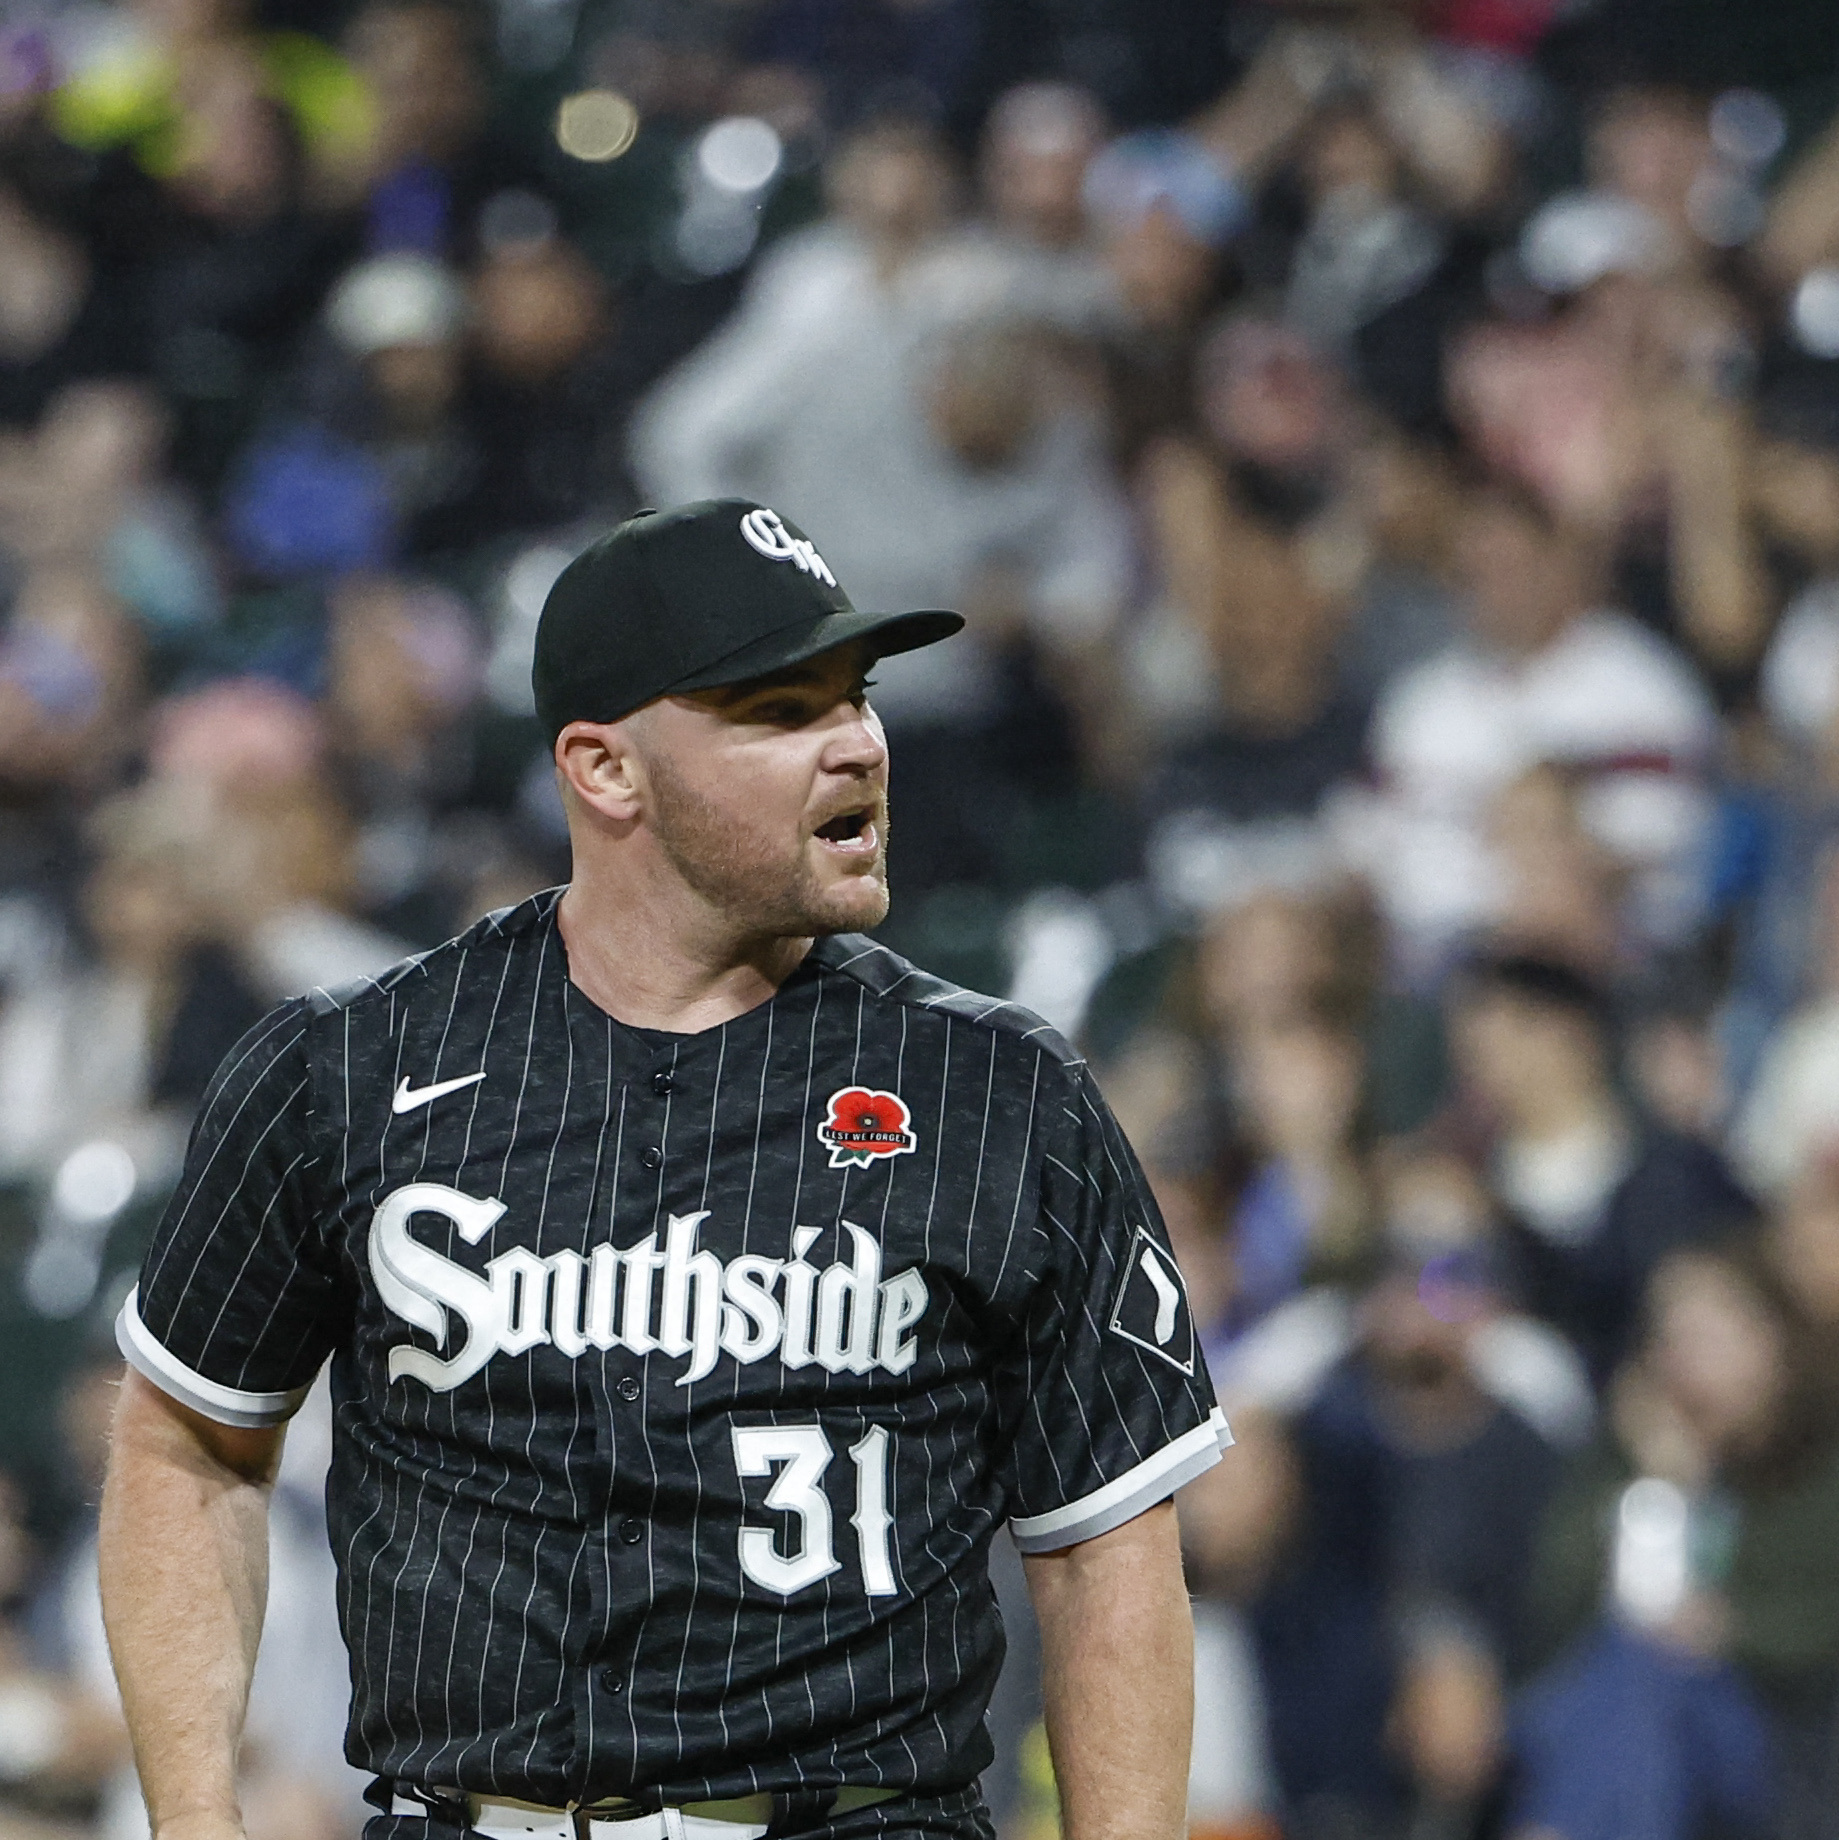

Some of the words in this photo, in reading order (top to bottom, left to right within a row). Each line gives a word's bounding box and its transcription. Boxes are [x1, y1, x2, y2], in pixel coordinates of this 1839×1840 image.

[825, 1130, 849, 1140] LEST
[852, 1132, 866, 1141] WE
[869, 1132, 907, 1143] FORGET
[367, 1182, 930, 1393] Southside
[731, 1423, 899, 1597] 31
